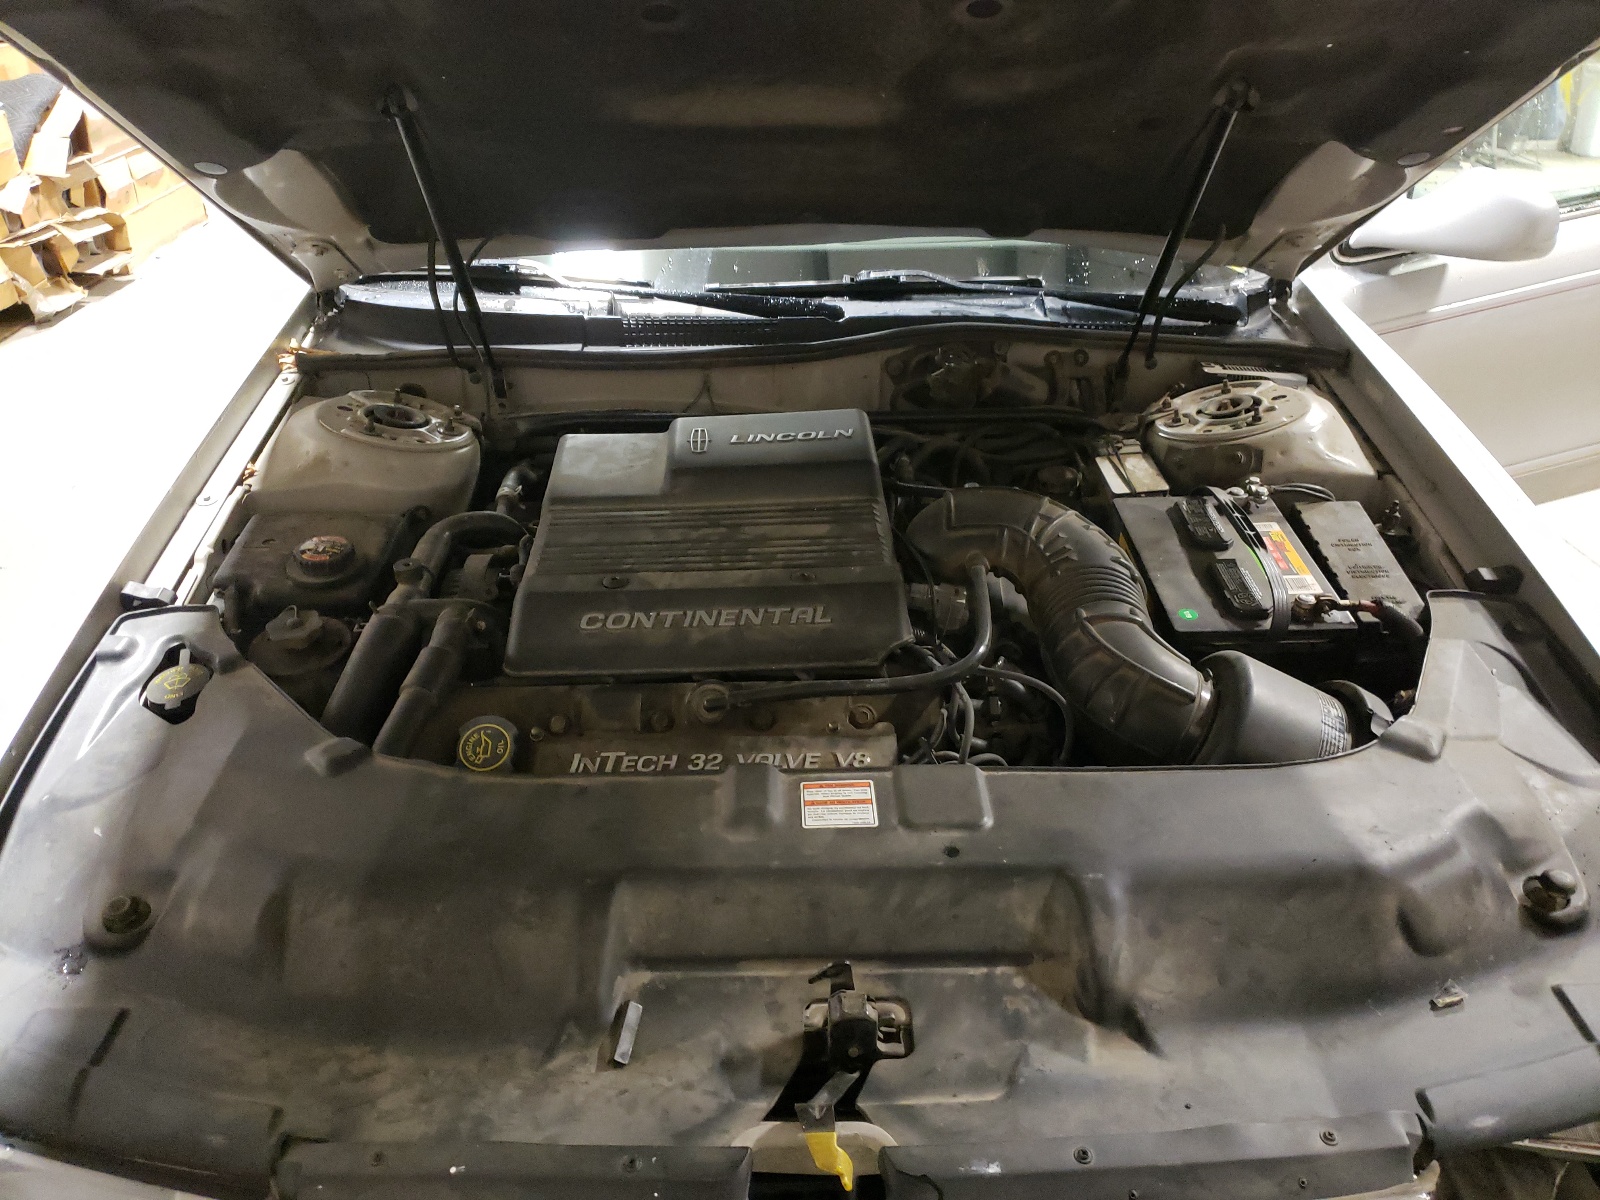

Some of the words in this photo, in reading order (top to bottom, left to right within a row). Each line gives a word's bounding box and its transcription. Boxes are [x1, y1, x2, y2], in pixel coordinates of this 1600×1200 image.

[730, 428, 854, 445] LINCOLN
[579, 606, 833, 632] CONTINENTAL
[465, 733, 480, 763] ENGINE
[496, 740, 505, 754] OIL
[687, 753, 723, 771] 32
[836, 752, 871, 768] V8
